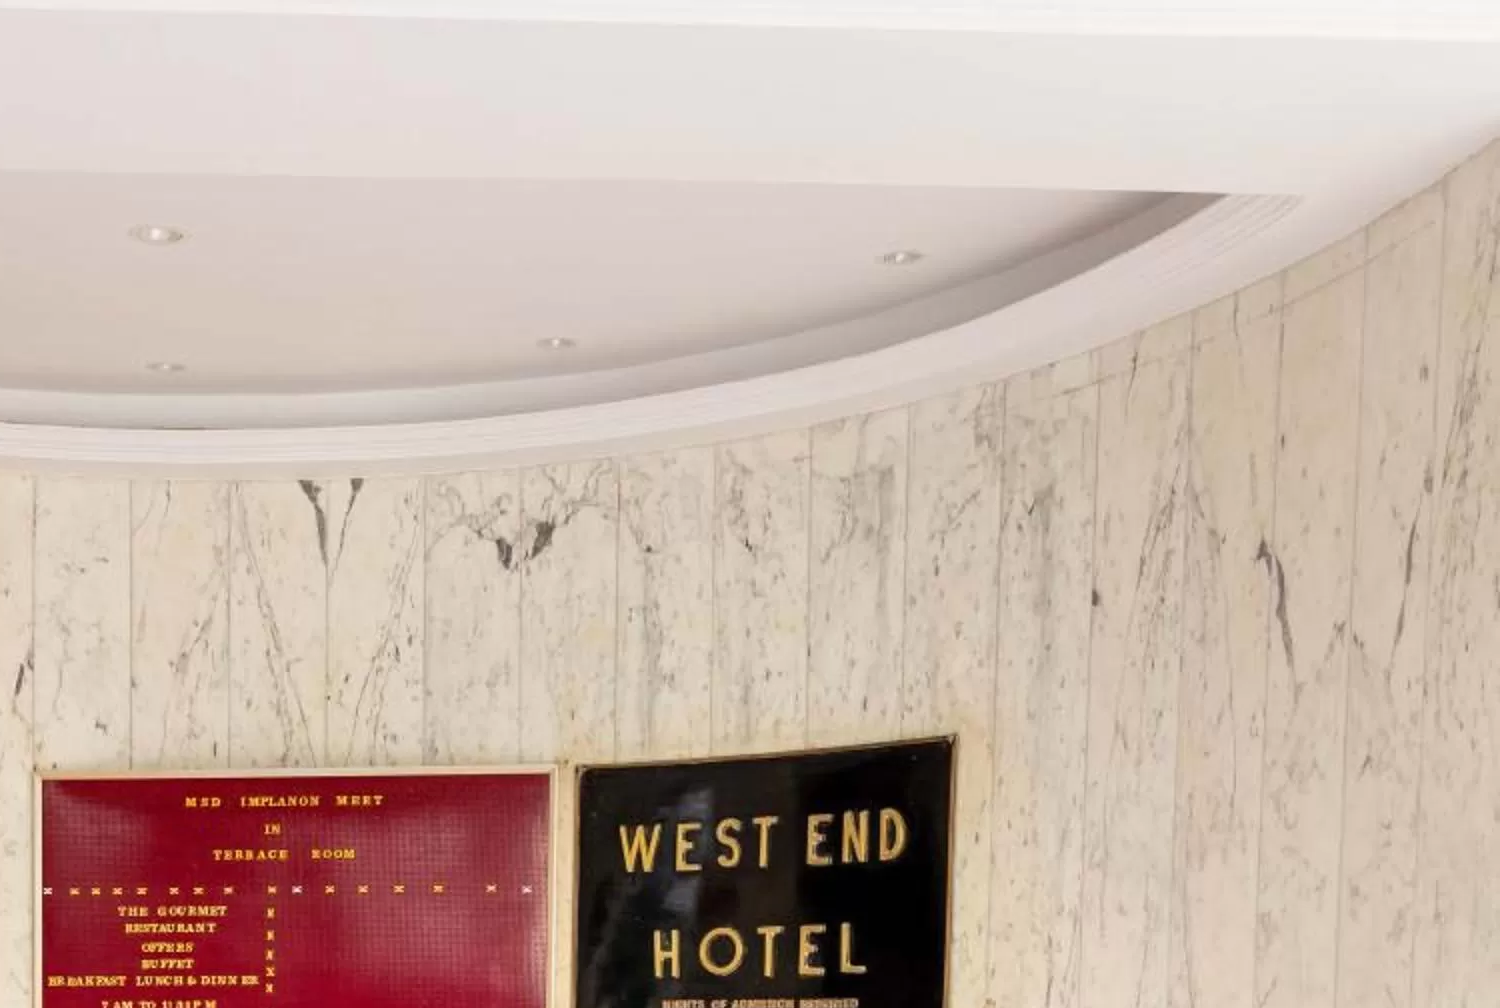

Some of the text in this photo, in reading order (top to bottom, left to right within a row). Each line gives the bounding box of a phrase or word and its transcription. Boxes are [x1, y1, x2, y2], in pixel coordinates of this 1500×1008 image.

[184, 794, 384, 808] MSD IMPLANON MEET
[263, 823, 281, 835] IN
[619, 807, 907, 873] WEST END
[212, 848, 356, 861] TERRACE ROOM
[117, 905, 228, 917] THE GOURMET
[124, 922, 217, 934] RESTAURANT
[141, 941, 195, 953] OFFERS
[653, 922, 867, 978] HOTEL
[140, 958, 195, 970] BUFFET
[47, 975, 128, 987] BREAKFAST
[135, 975, 184, 987] LUNCH
[200, 974, 260, 986] DINNER
